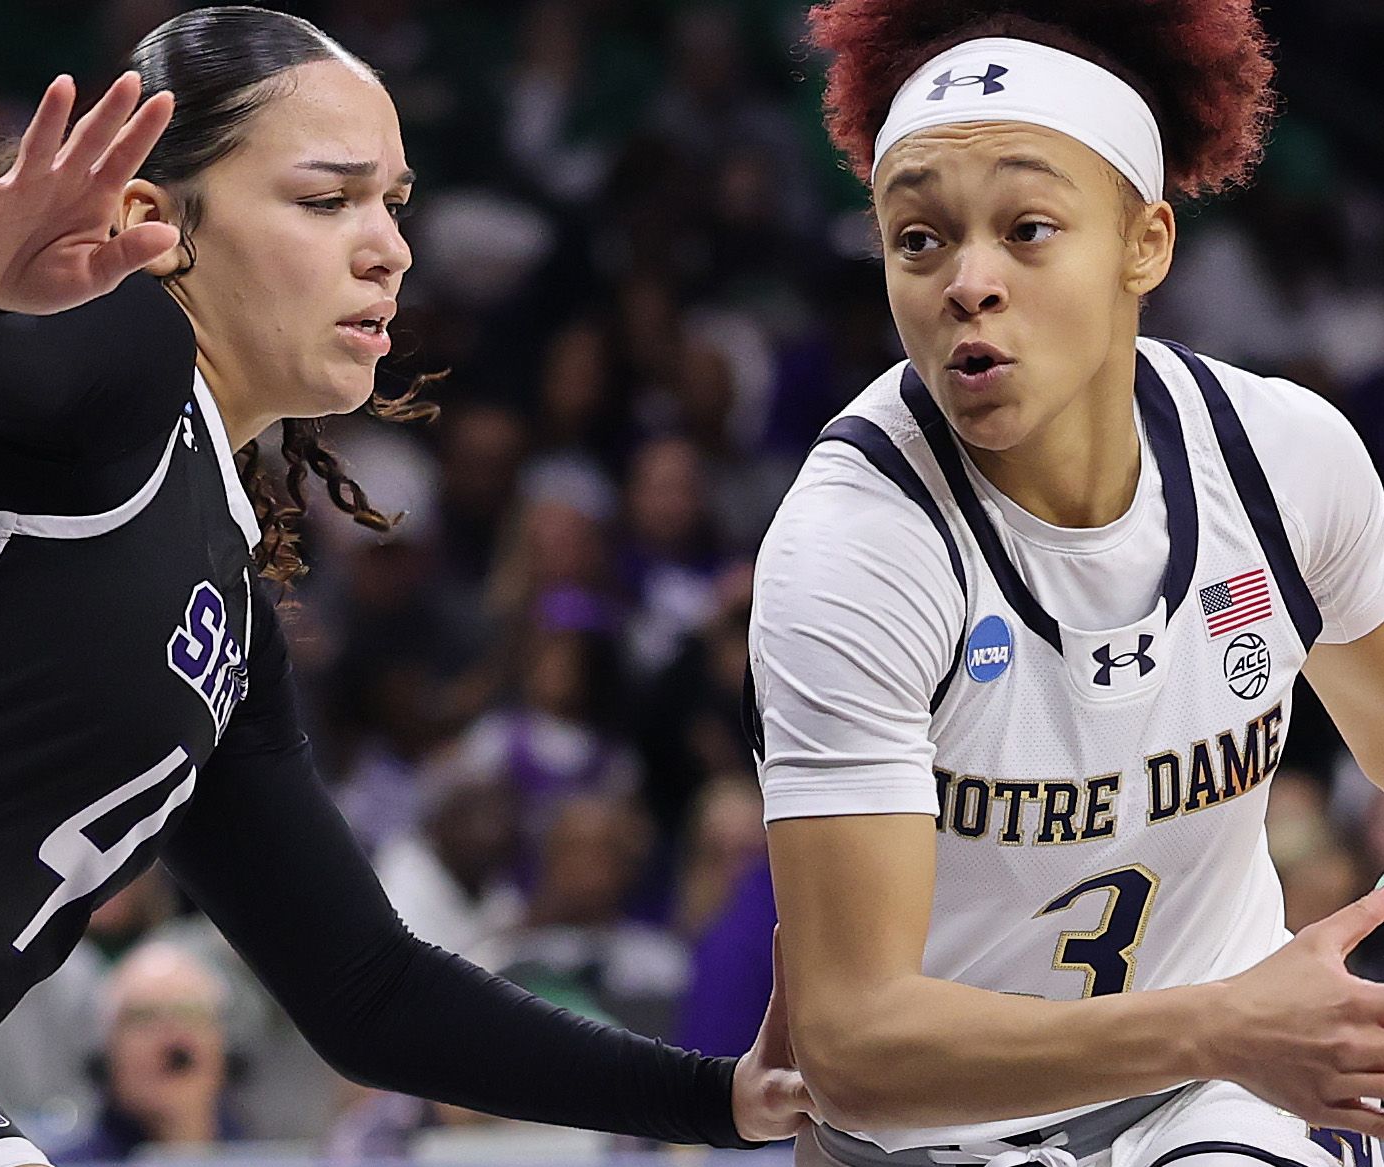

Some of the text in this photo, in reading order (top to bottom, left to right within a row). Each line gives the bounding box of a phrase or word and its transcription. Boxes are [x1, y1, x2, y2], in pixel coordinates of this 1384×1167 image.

[970, 645, 1009, 667] NCAA
[1230, 646, 1268, 676] ACC
[1144, 700, 1283, 826] DAME
[11, 744, 197, 953] 4
[1009, 861, 1162, 1000] 3
